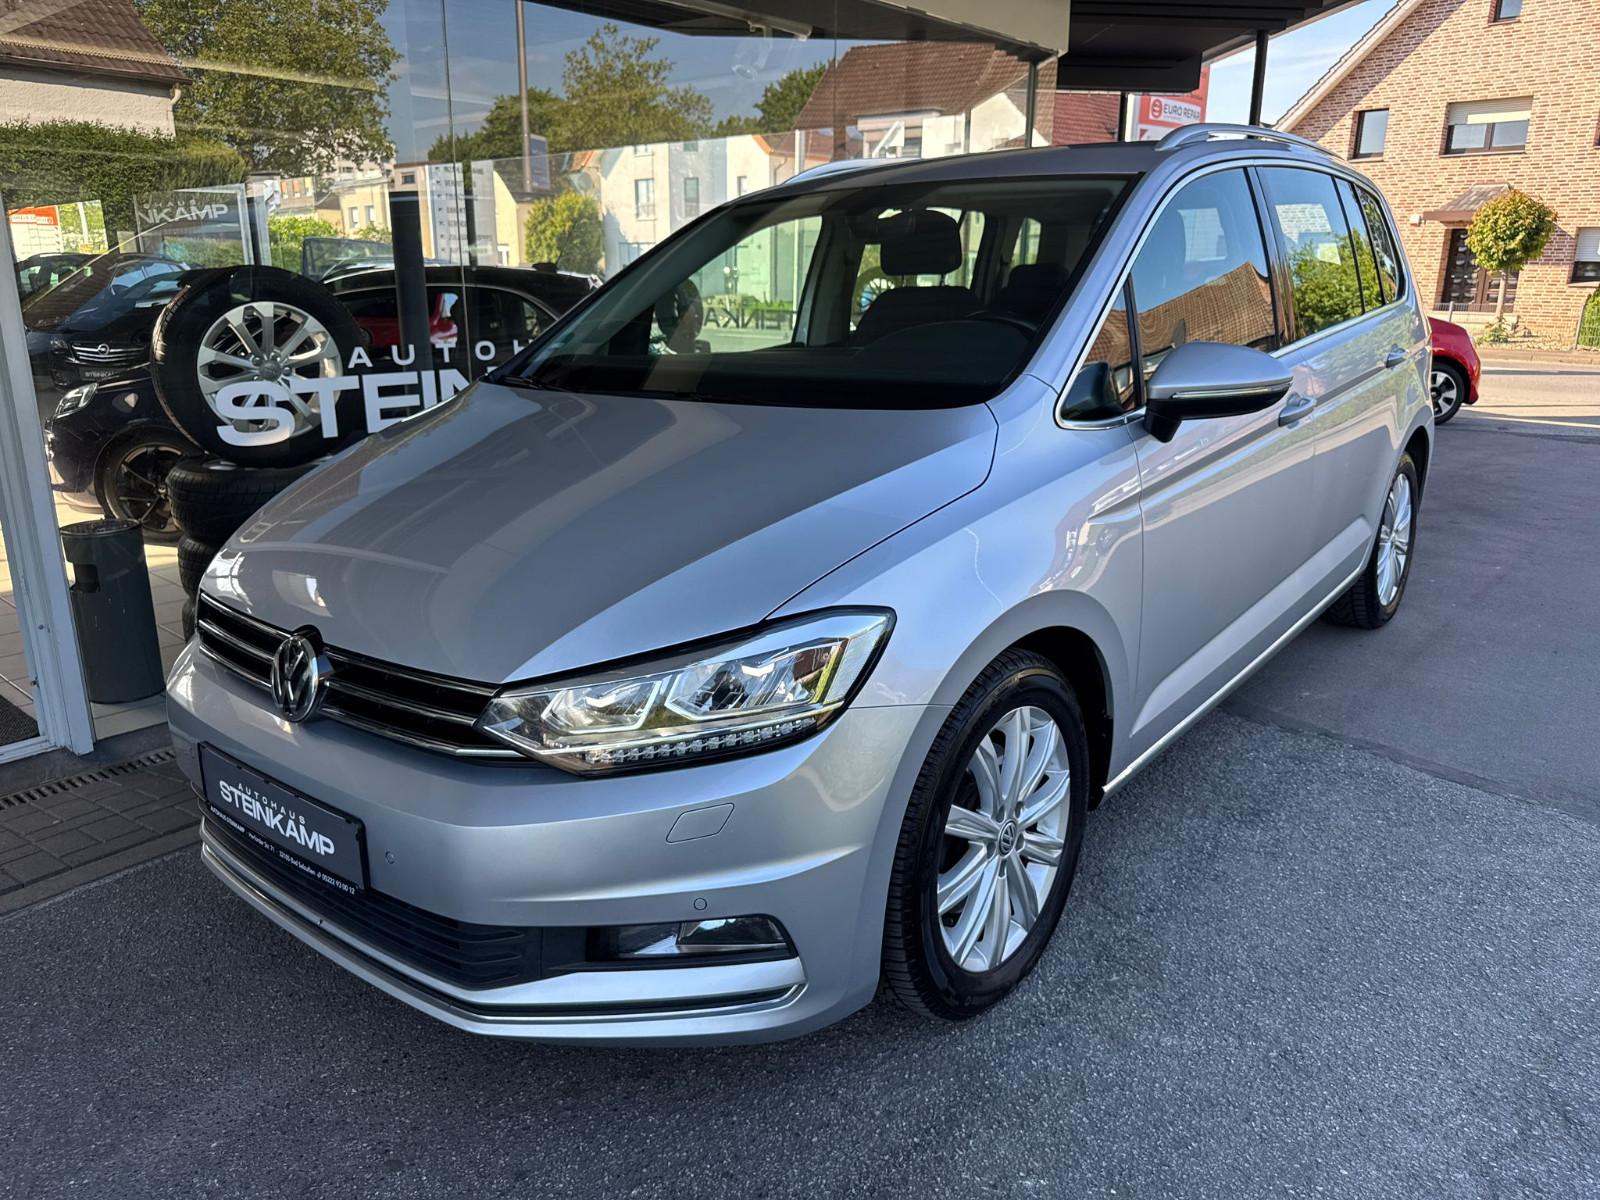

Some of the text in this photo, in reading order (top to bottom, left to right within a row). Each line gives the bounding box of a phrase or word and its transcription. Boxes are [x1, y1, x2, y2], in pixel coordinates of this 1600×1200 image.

[1163, 103, 1182, 116] EURO
[219, 780, 335, 856] STEINKAMP
[238, 783, 306, 824] AUTOHAUS
